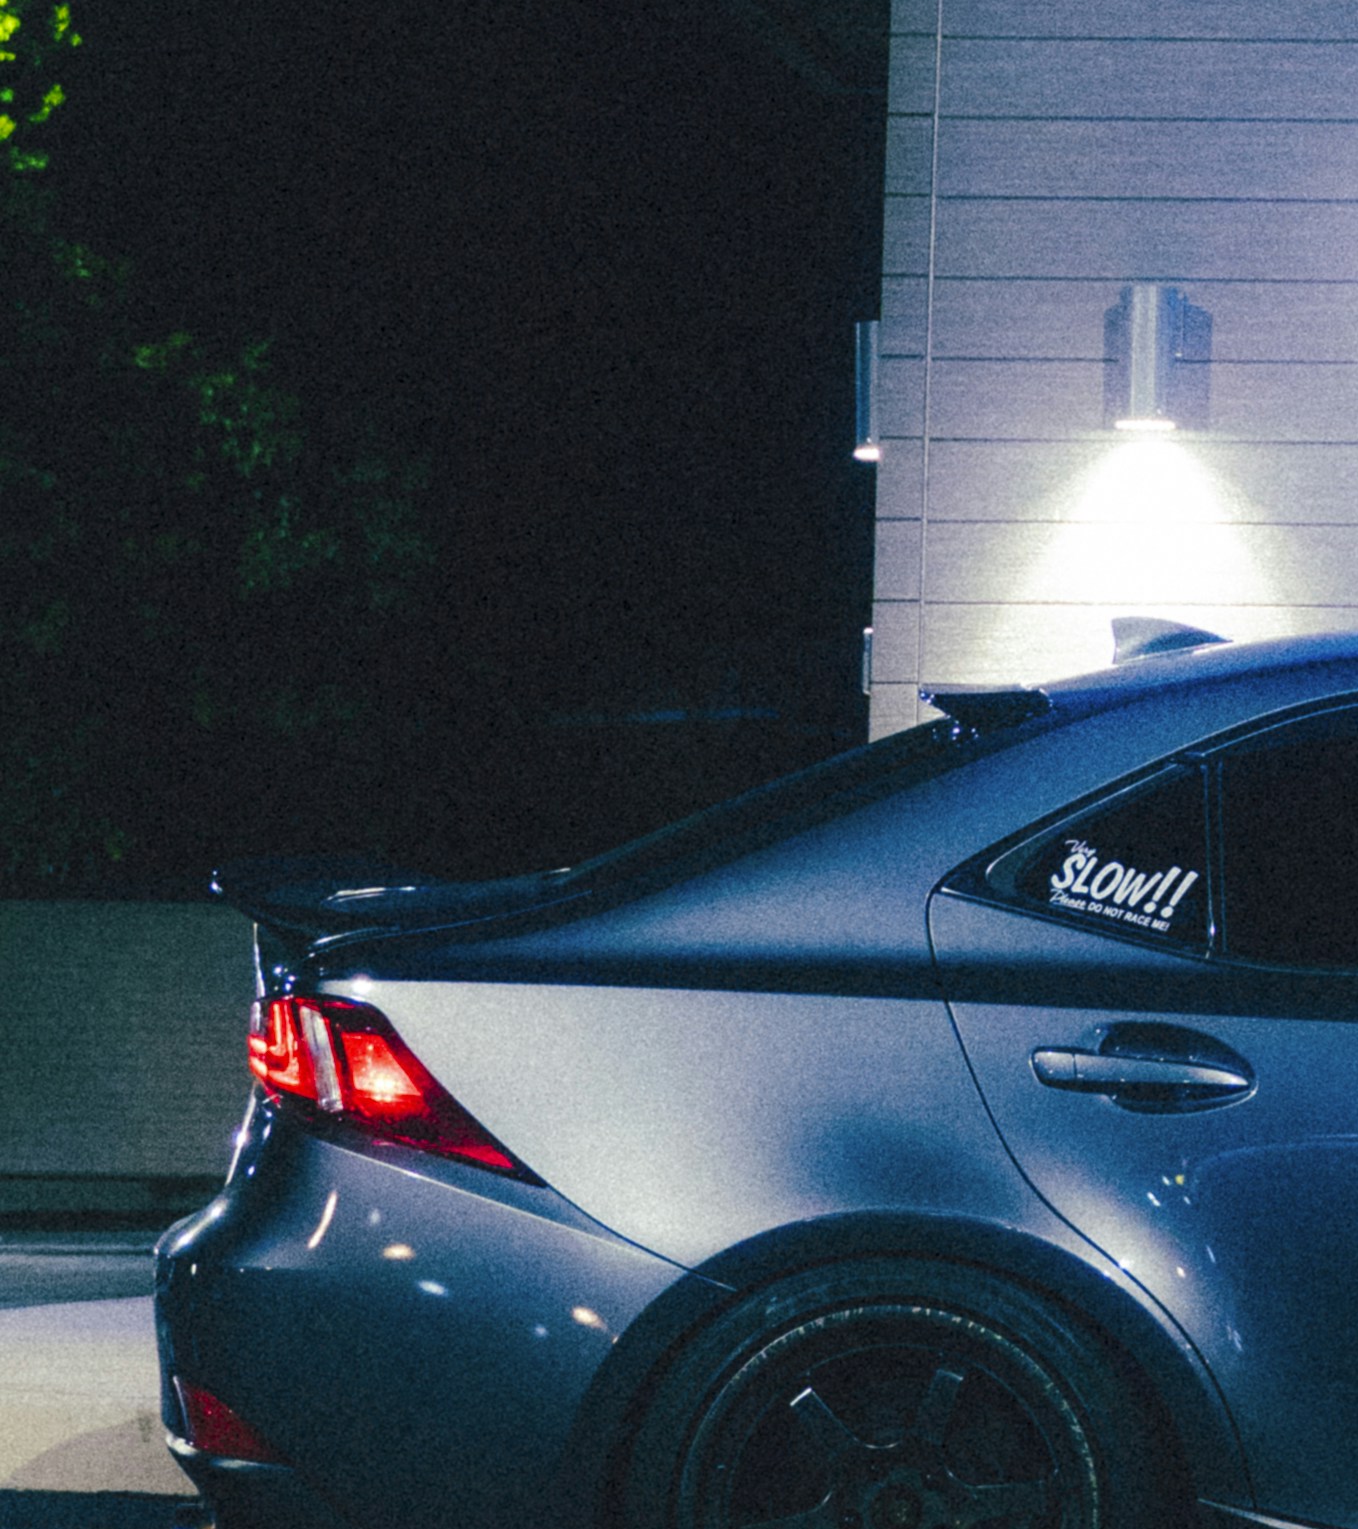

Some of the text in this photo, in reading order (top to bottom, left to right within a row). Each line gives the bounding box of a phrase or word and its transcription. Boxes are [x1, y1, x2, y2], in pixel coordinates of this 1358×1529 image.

[1050, 853, 1199, 919] SLOW!!
[1087, 901, 1103, 914] DO
[1103, 905, 1125, 920] NOT
[1124, 911, 1151, 927] RACE
[1150, 918, 1171, 933] ME!
